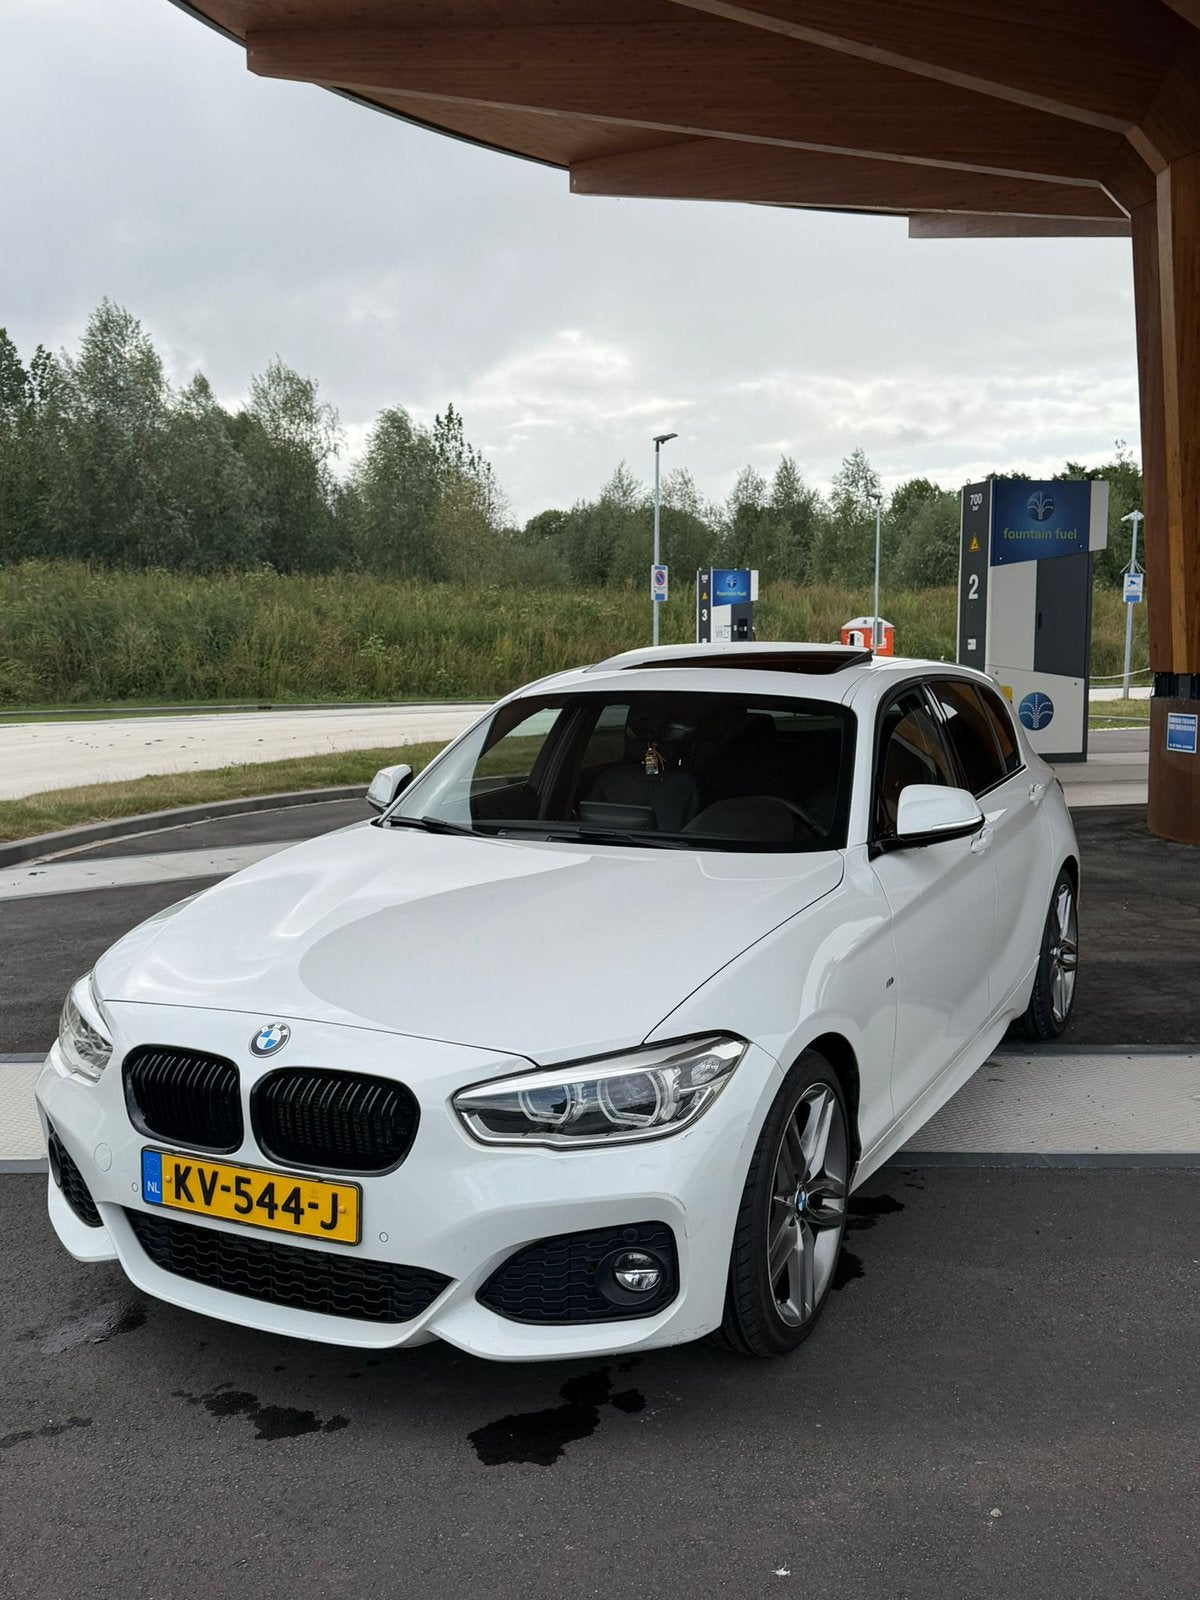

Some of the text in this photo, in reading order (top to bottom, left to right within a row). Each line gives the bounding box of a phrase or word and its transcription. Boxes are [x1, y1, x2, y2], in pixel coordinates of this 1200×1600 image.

[969, 493, 983, 505] 700
[1003, 527, 1077, 540] fountain fuel
[968, 574, 978, 600] 2
[702, 609, 708, 621] 3
[147, 1180, 161, 1194] NL
[173, 1163, 339, 1231] KV-544-J
